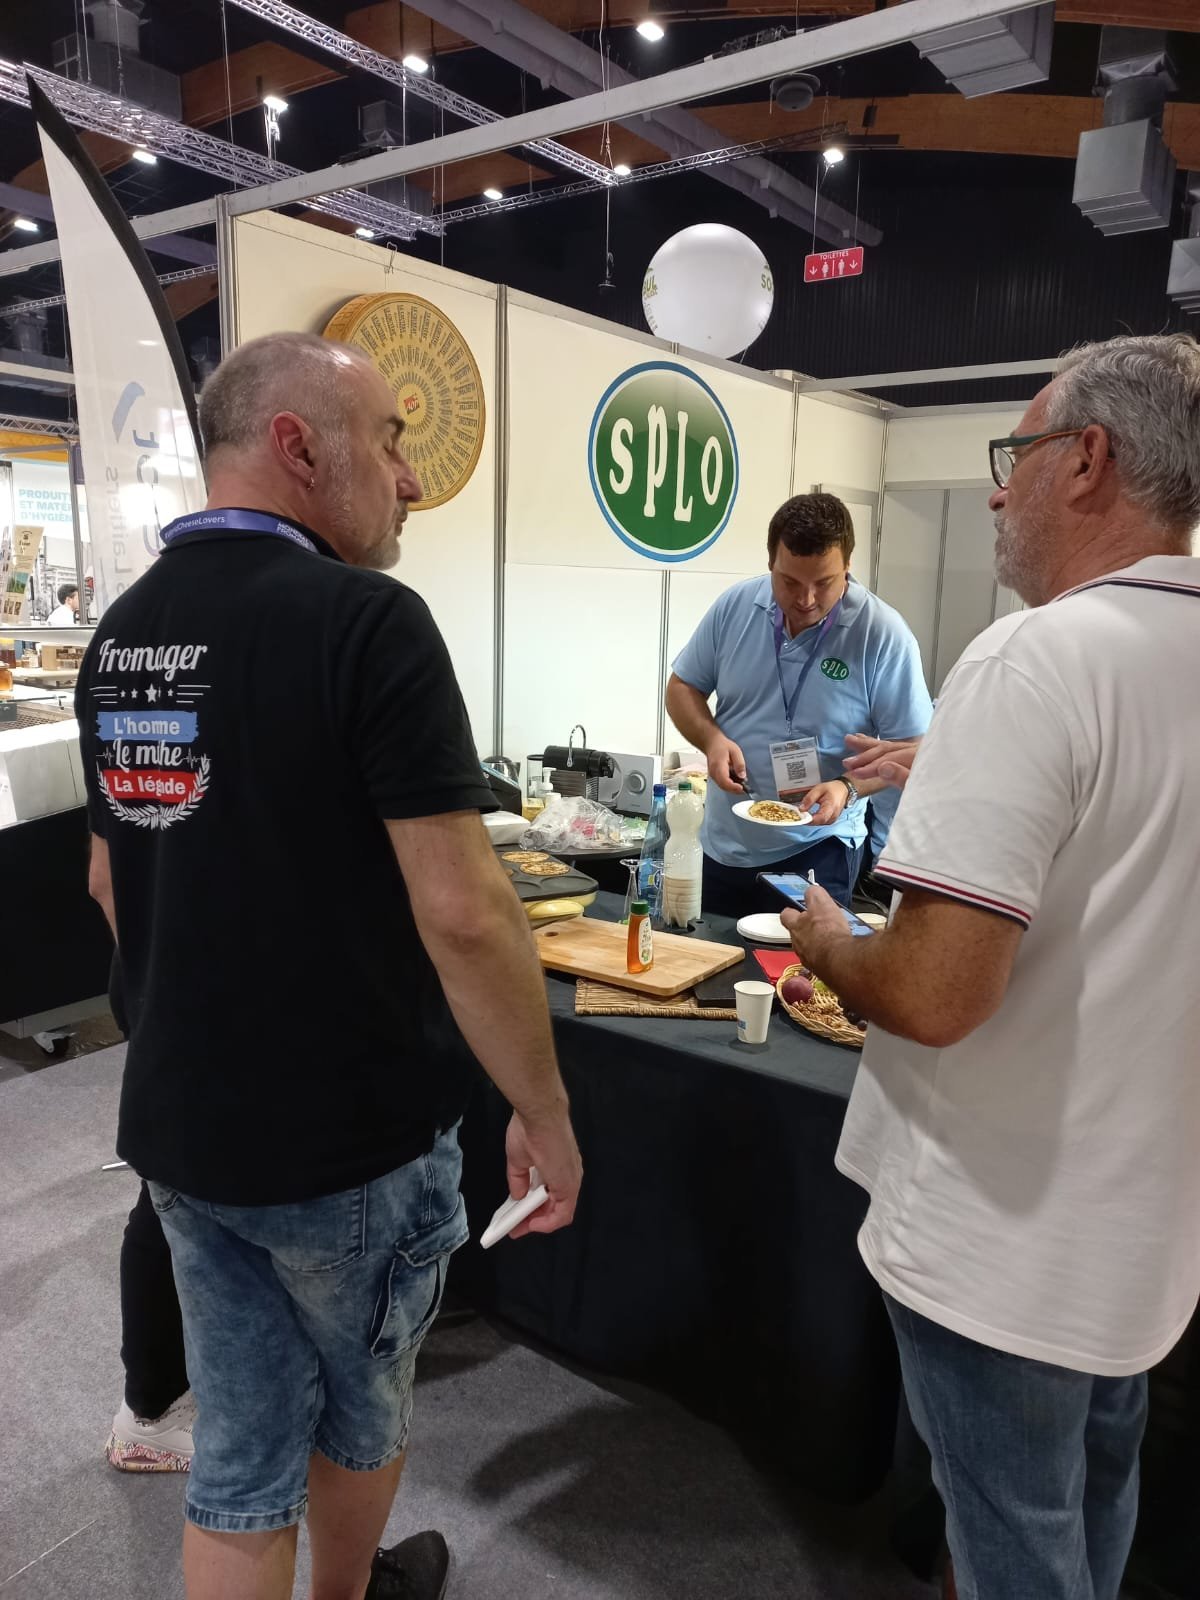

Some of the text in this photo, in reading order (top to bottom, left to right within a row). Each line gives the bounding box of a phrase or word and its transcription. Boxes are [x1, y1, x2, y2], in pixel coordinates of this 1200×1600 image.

[820, 250, 849, 260] TOILETTES
[609, 404, 723, 522] SPLO
[18, 488, 71, 501] PRODUIT
[19, 500, 34, 509] ET
[20, 511, 73, 522] D'HYGIÈN
[821, 659, 848, 677] SPLO
[113, 737, 131, 773] Le
[114, 776, 134, 792] La
